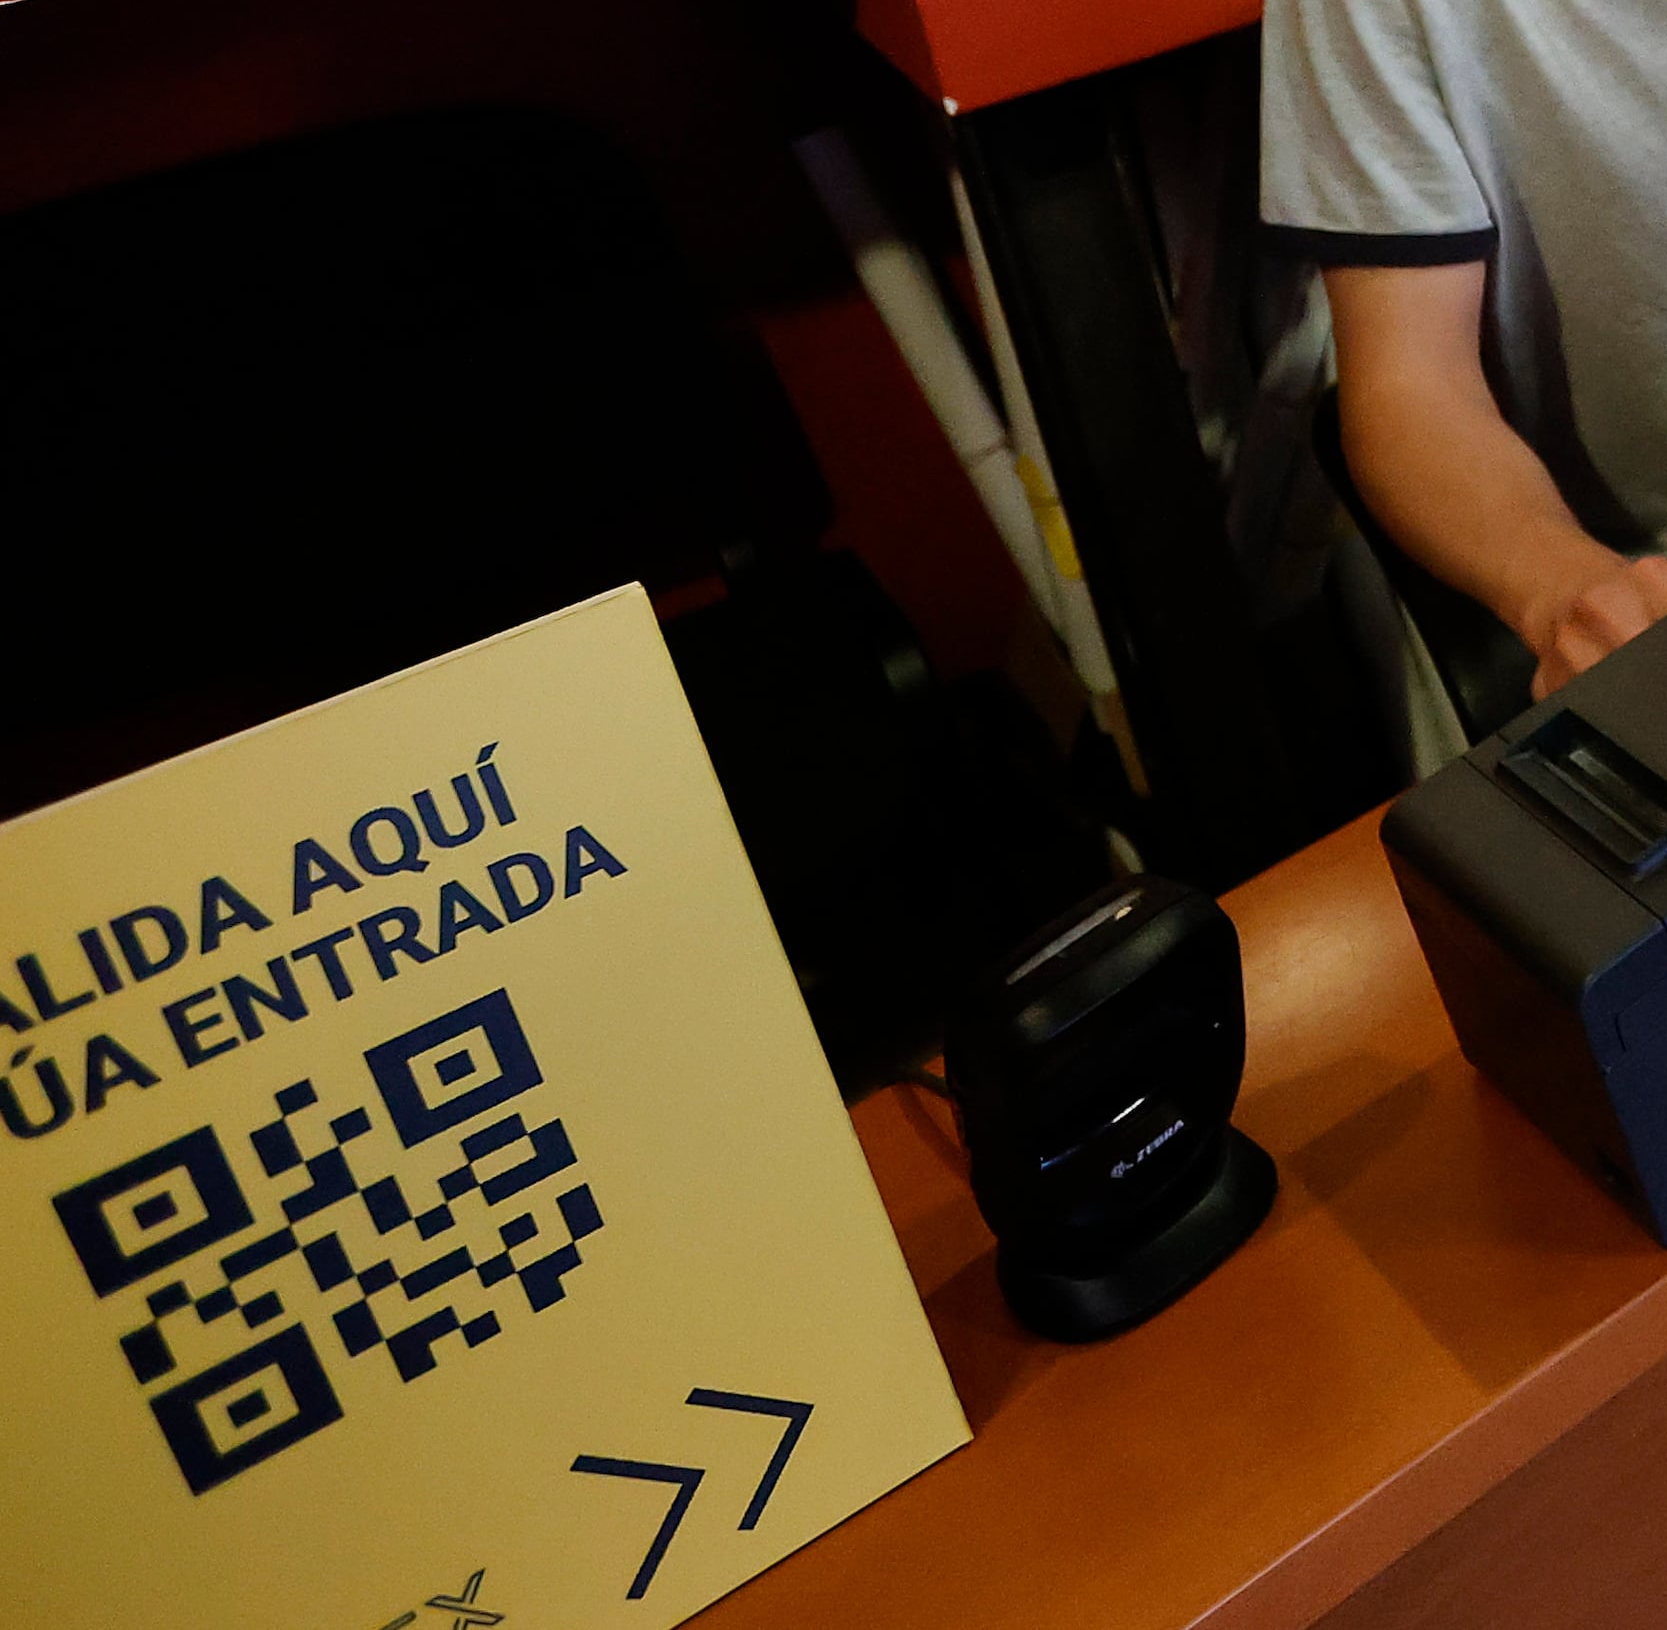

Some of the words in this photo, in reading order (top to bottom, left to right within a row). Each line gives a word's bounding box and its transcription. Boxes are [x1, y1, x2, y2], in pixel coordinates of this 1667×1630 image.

[293, 741, 517, 916] AQUÍ
[162, 826, 629, 1070] ENTRADA
[1137, 1120, 1184, 1163] ZEBRA
